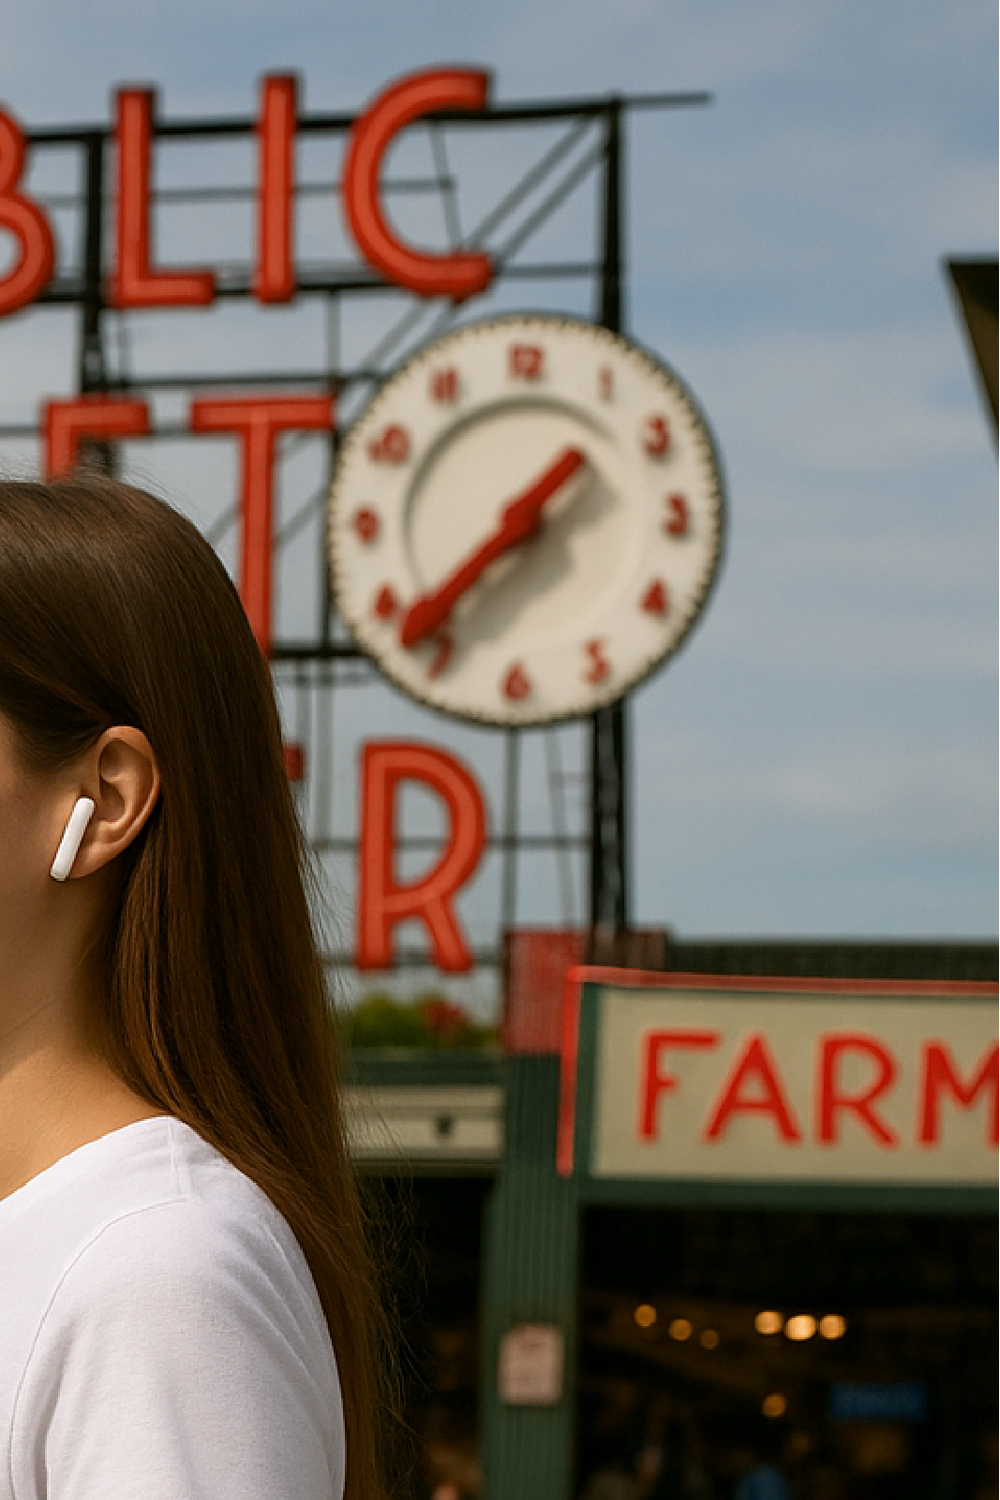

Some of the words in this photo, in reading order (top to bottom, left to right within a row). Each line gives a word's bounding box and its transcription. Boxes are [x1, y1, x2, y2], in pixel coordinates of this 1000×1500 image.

[508, 343, 546, 380] 12
[663, 491, 688, 537] 3
[636, 1027, 1000, 1152] FARM
